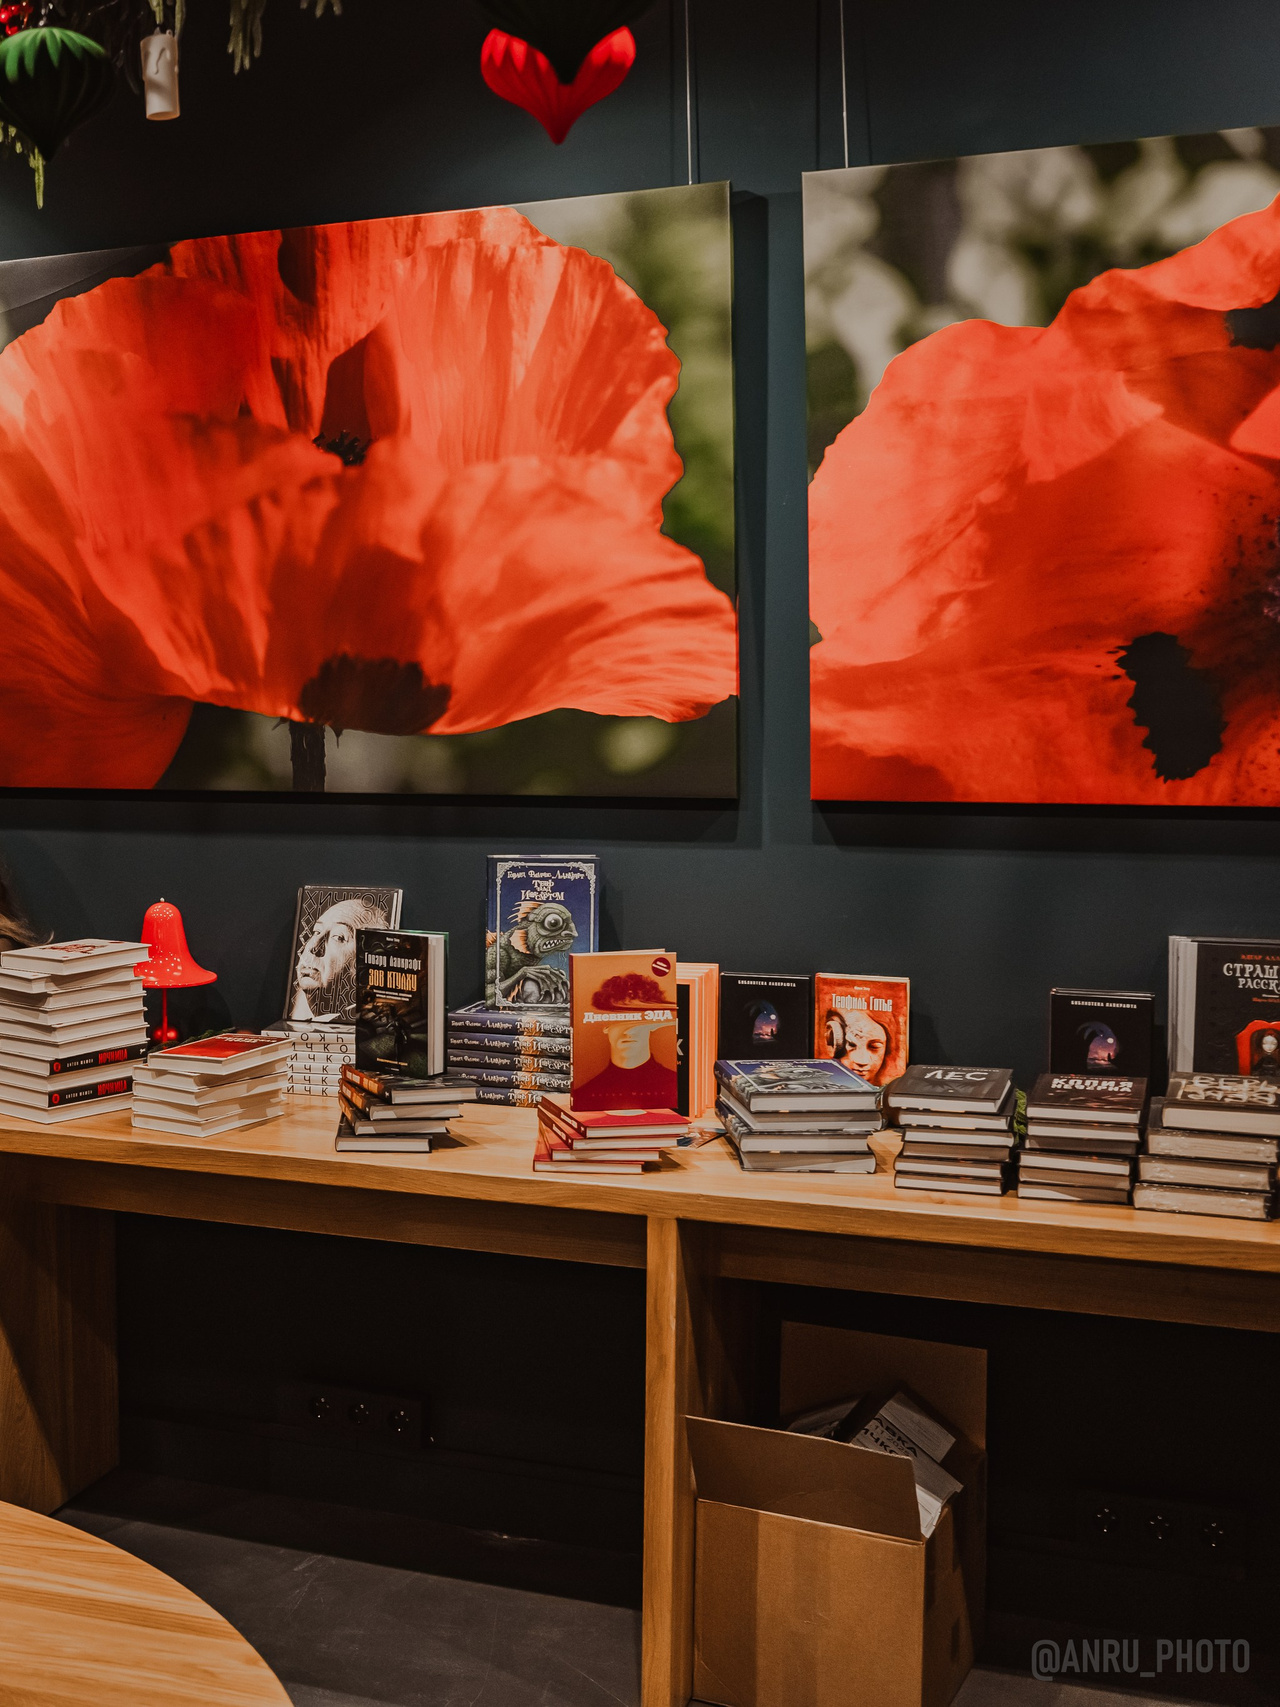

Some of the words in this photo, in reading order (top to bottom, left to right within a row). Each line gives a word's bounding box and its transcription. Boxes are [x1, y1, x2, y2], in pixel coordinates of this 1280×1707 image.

[1222, 962, 1279, 979] СТРАШ
[368, 968, 385, 987] ЗОВ
[387, 970, 417, 992] КТУЛХУ
[1238, 977, 1280, 994] РАССК
[583, 1011, 642, 1024] Дневник
[644, 1009, 673, 1021] ЭДА
[98, 1048, 128, 1064] НОЧНИЦА
[924, 1069, 989, 1081] ЛЕС
[97, 1080, 127, 1096] НОЧНИЦА
